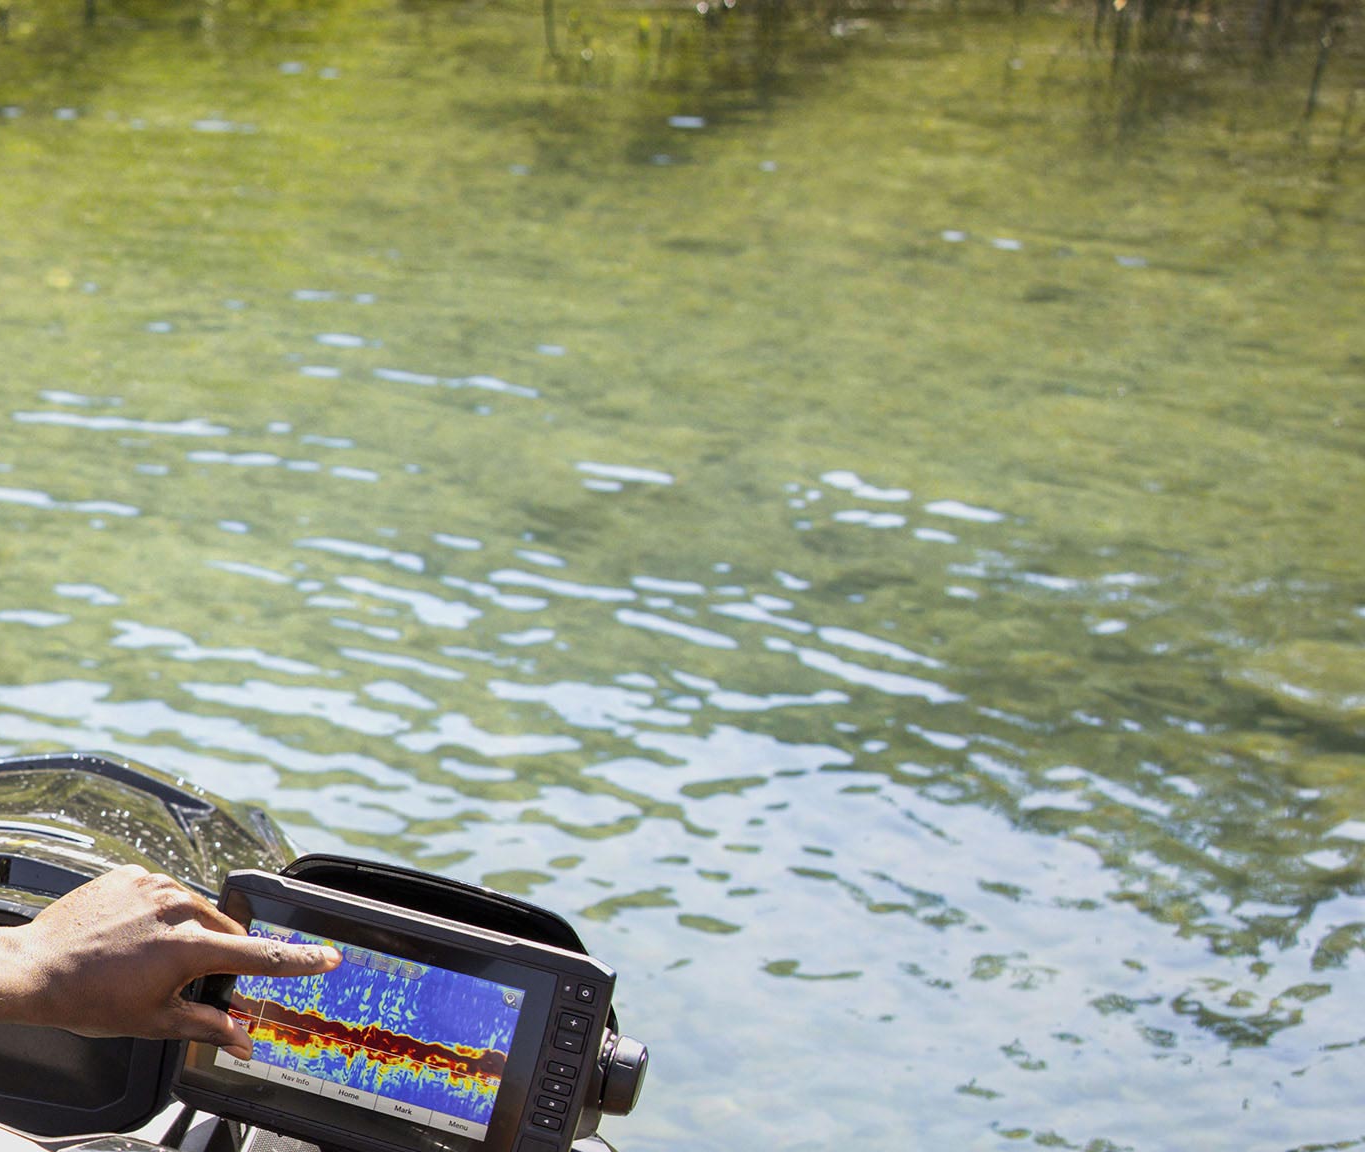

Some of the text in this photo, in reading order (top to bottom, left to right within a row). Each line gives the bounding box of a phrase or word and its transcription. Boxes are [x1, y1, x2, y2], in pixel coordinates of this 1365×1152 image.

[233, 1059, 251, 1070] Back
[281, 1073, 310, 1086] Nav Info
[338, 1089, 360, 1100] Home
[393, 1104, 413, 1116] Mark
[448, 1120, 469, 1132] Menu
